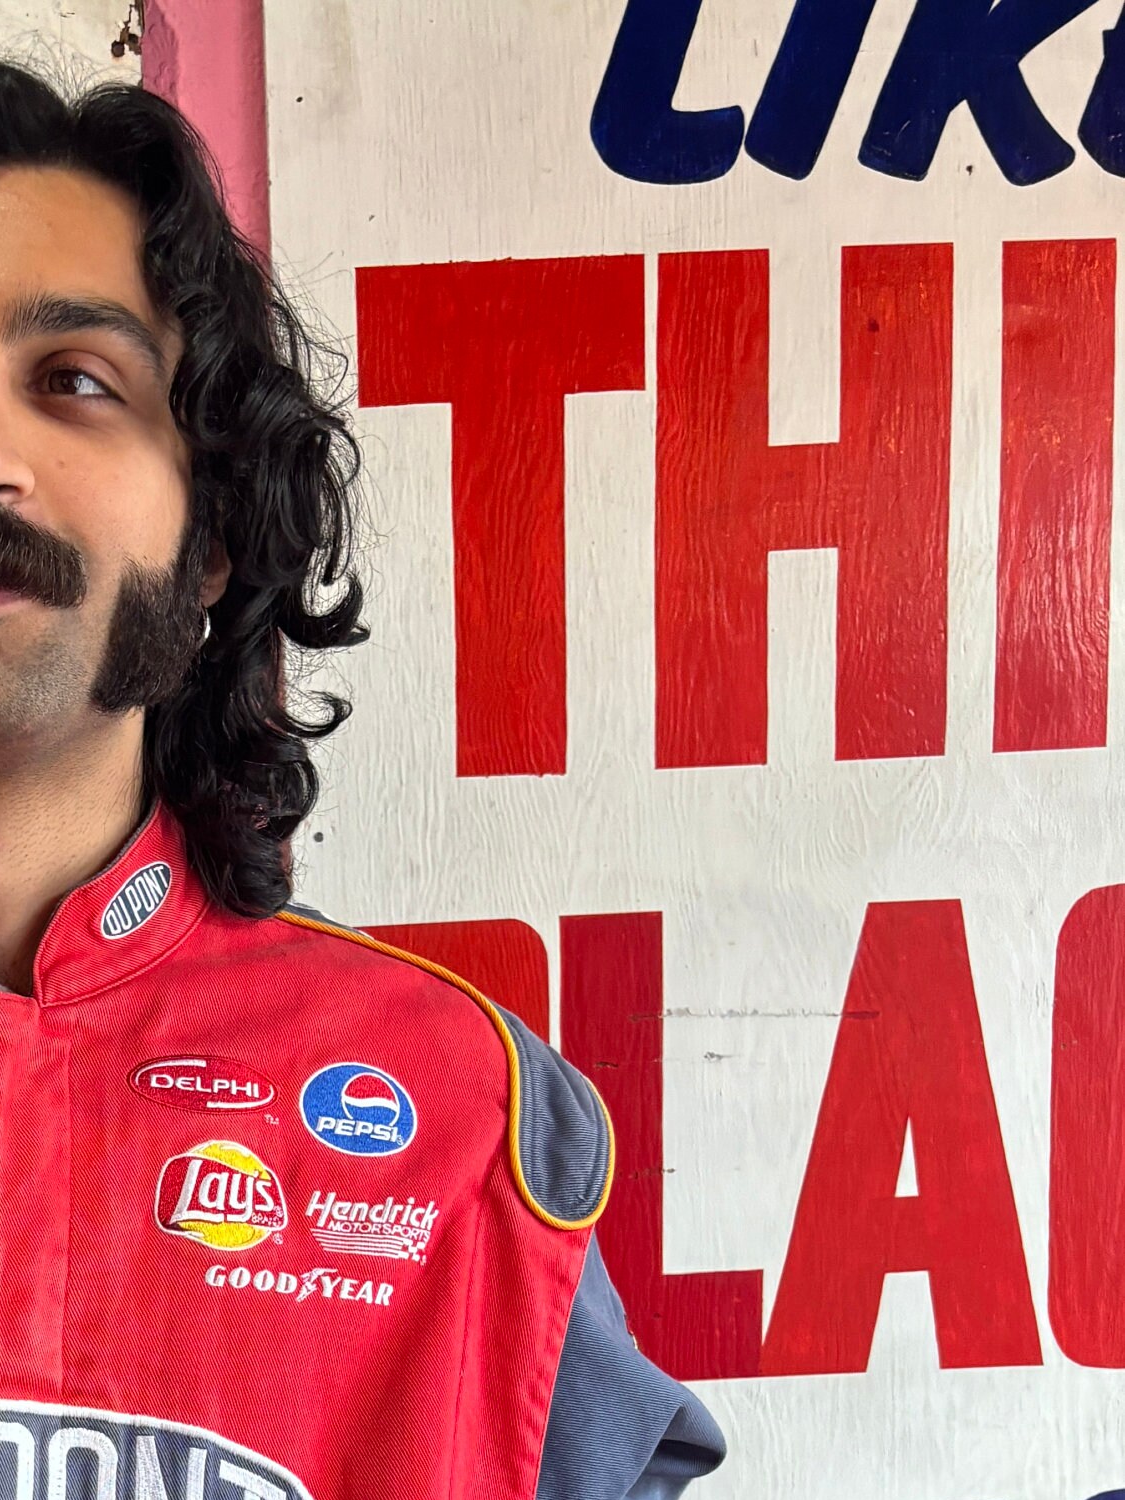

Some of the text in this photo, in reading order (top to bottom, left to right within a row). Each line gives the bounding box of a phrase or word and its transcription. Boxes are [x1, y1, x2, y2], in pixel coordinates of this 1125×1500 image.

[355, 238, 1118, 778] THI
[150, 1073, 260, 1098] DELPHI
[315, 1116, 399, 1142] PEPSI
[375, 883, 1125, 1381] LA
[169, 1159, 274, 1224] Lay's
[305, 1190, 439, 1229] Hendrick
[327, 1221, 431, 1242] MOTORSPORTS
